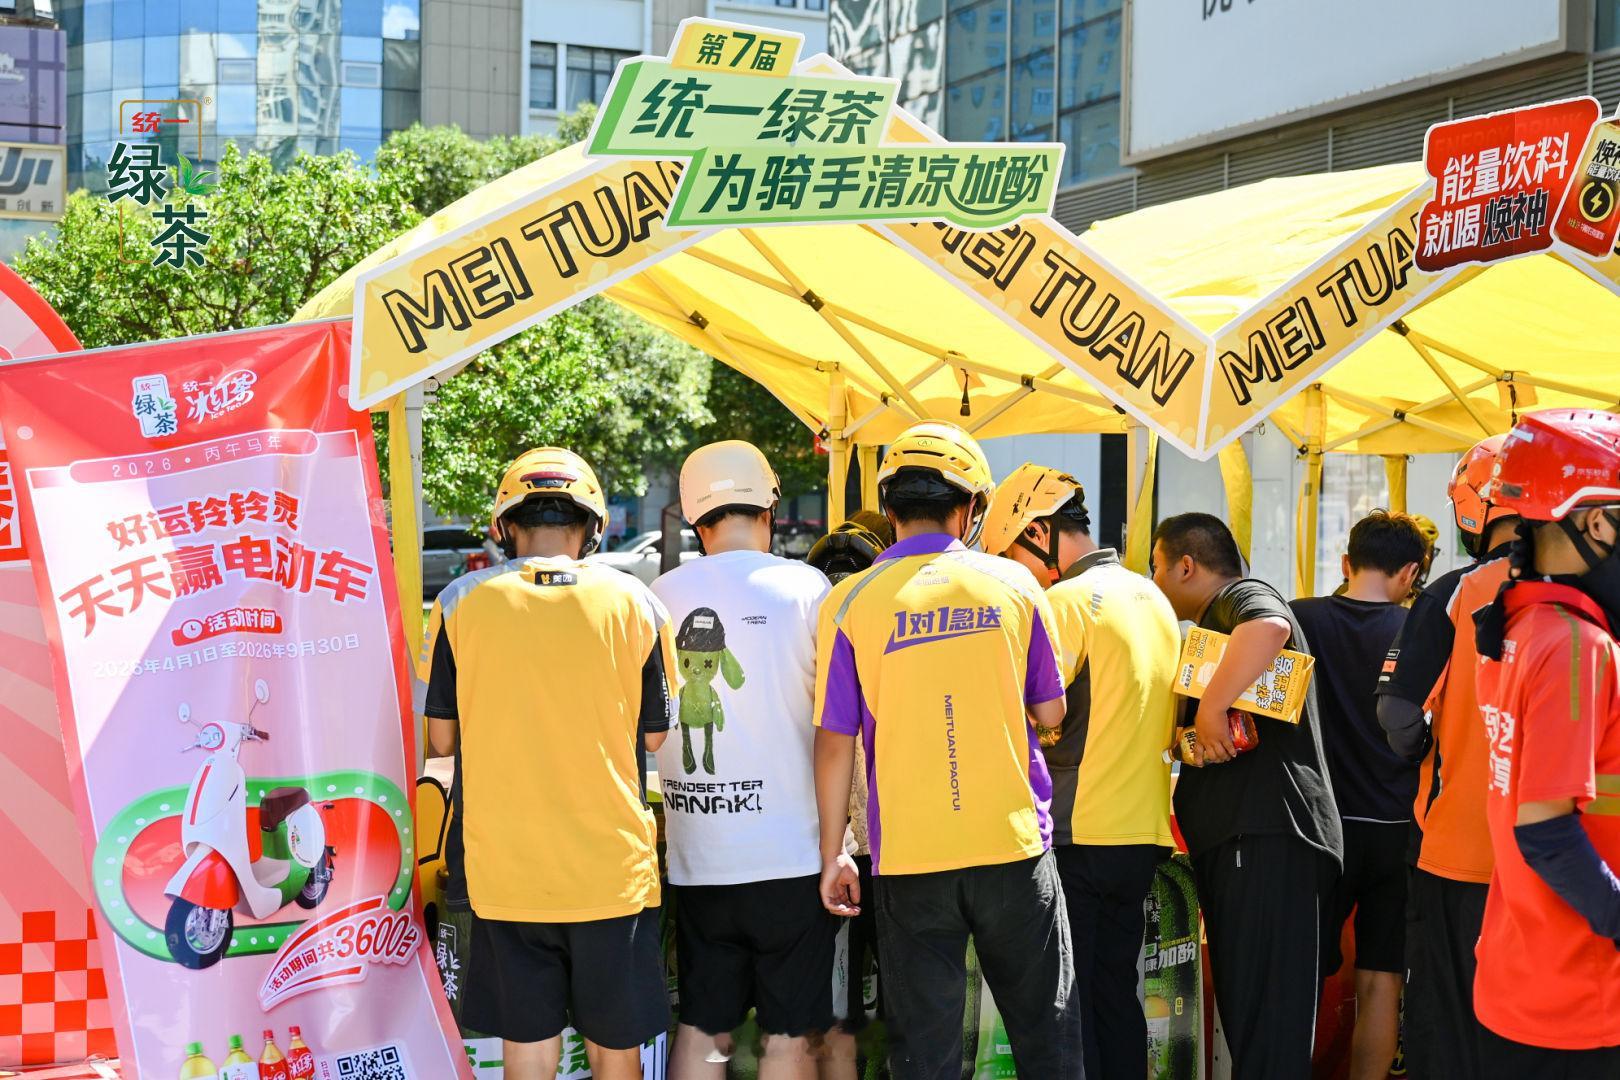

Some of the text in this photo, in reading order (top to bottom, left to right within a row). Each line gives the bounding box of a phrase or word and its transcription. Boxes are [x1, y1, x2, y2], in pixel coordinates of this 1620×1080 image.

[696, 31, 782, 72] 第7届
[628, 76, 885, 146] 统一绿茶
[698, 152, 1050, 215] 为骑手清凉加酚
[1441, 132, 1570, 206] 能量饮料
[1422, 187, 1550, 258] 就喝焕神
[382, 237, 534, 354] MEI
[909, 222, 1195, 408] EI TUAN
[1218, 211, 1419, 406] MEI TUA
[135, 393, 176, 434] 绿茶
[111, 434, 282, 478] 2026 丙午马年
[106, 489, 300, 552] 好运铃铃灵
[58, 535, 374, 639] 天天赢电动车
[207, 608, 278, 633] 活动时间
[894, 606, 1002, 638] 1对1急送
[92, 633, 360, 679] 2026年4月1日至2026年9月30日
[944, 694, 961, 812] MEITUAN PAOTUI
[269, 914, 418, 992] 活动期间共3600台
